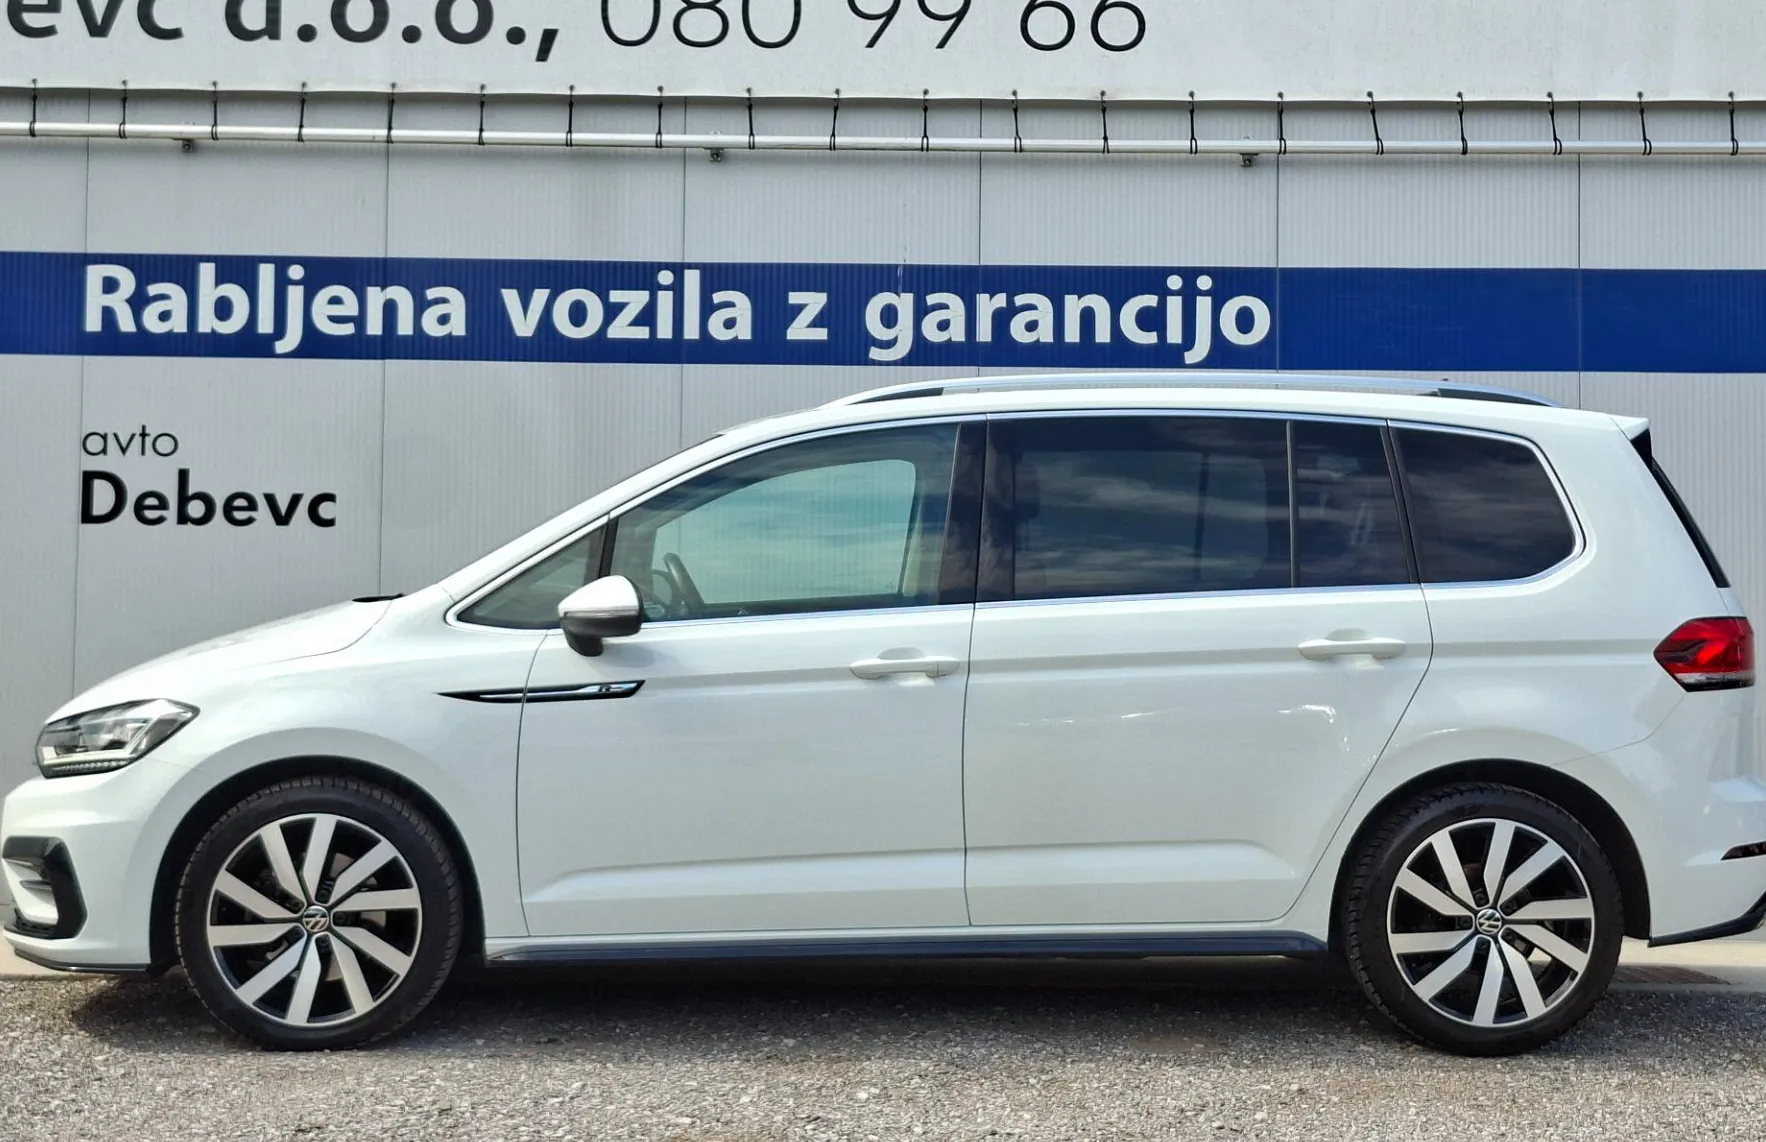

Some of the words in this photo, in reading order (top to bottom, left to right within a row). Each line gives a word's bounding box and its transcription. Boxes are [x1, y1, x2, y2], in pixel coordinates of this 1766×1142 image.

[600, 0, 802, 48] 080
[846, 0, 972, 49] 99
[1019, 0, 1146, 52] 66
[84, 261, 467, 355] Rabljena
[500, 267, 753, 341] vozila
[786, 291, 829, 341] z
[865, 274, 1272, 365] garancijo
[81, 424, 180, 458] avto
[80, 468, 337, 528] Debevc
